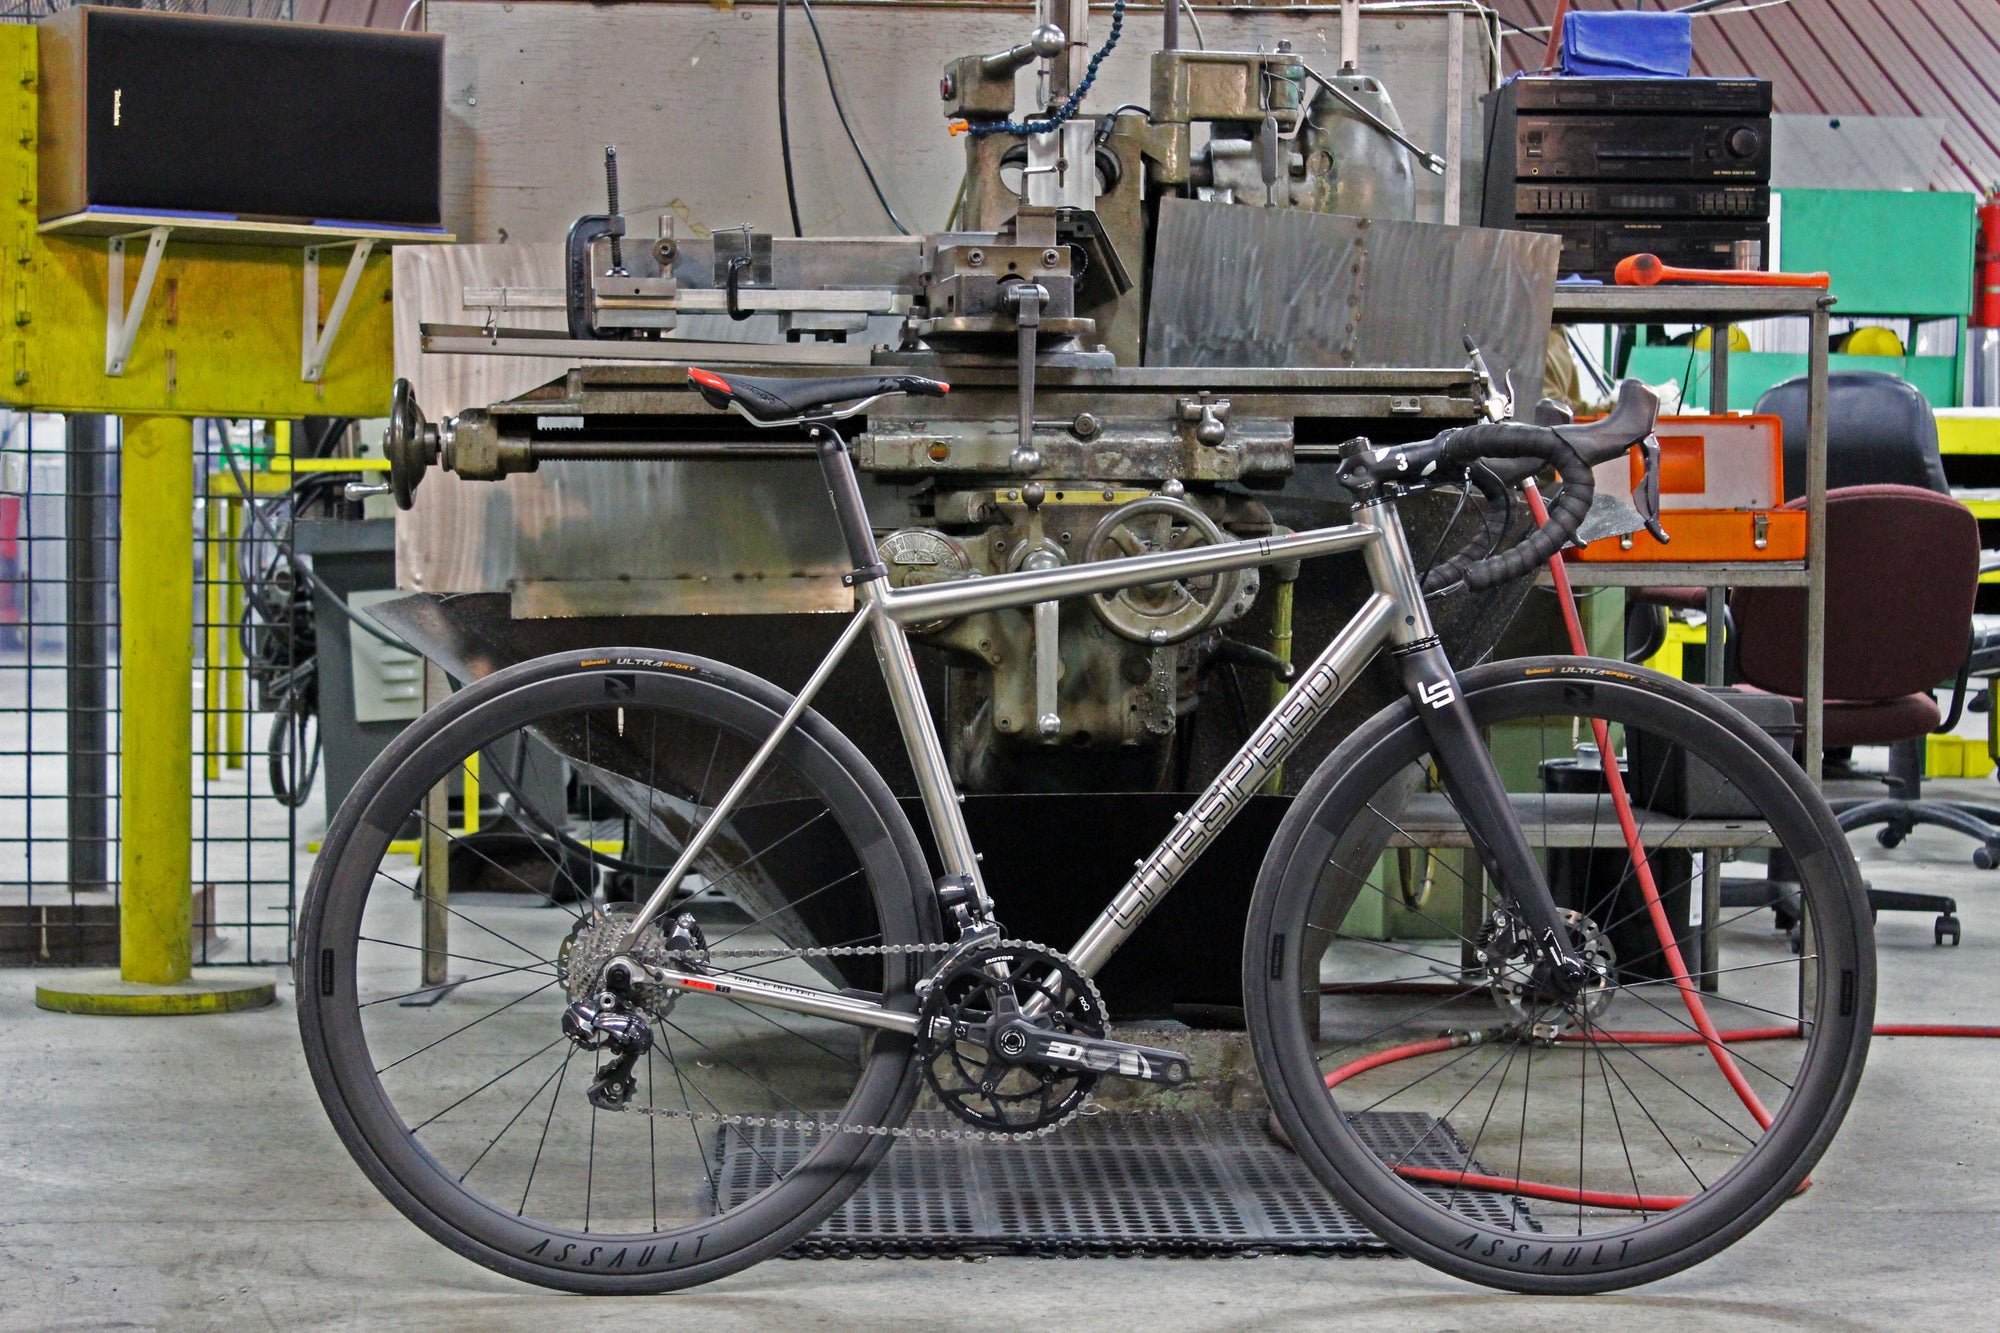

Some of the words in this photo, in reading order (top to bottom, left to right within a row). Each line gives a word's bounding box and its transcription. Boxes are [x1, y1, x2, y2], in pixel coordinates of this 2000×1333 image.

[1395, 452, 1409, 472] 3
[1106, 663, 1340, 929] LITESPEED
[985, 955, 1014, 964] ROTOR
[527, 1234, 709, 1268] ASSAULT
[1456, 1233, 1635, 1267] ASSAULT
